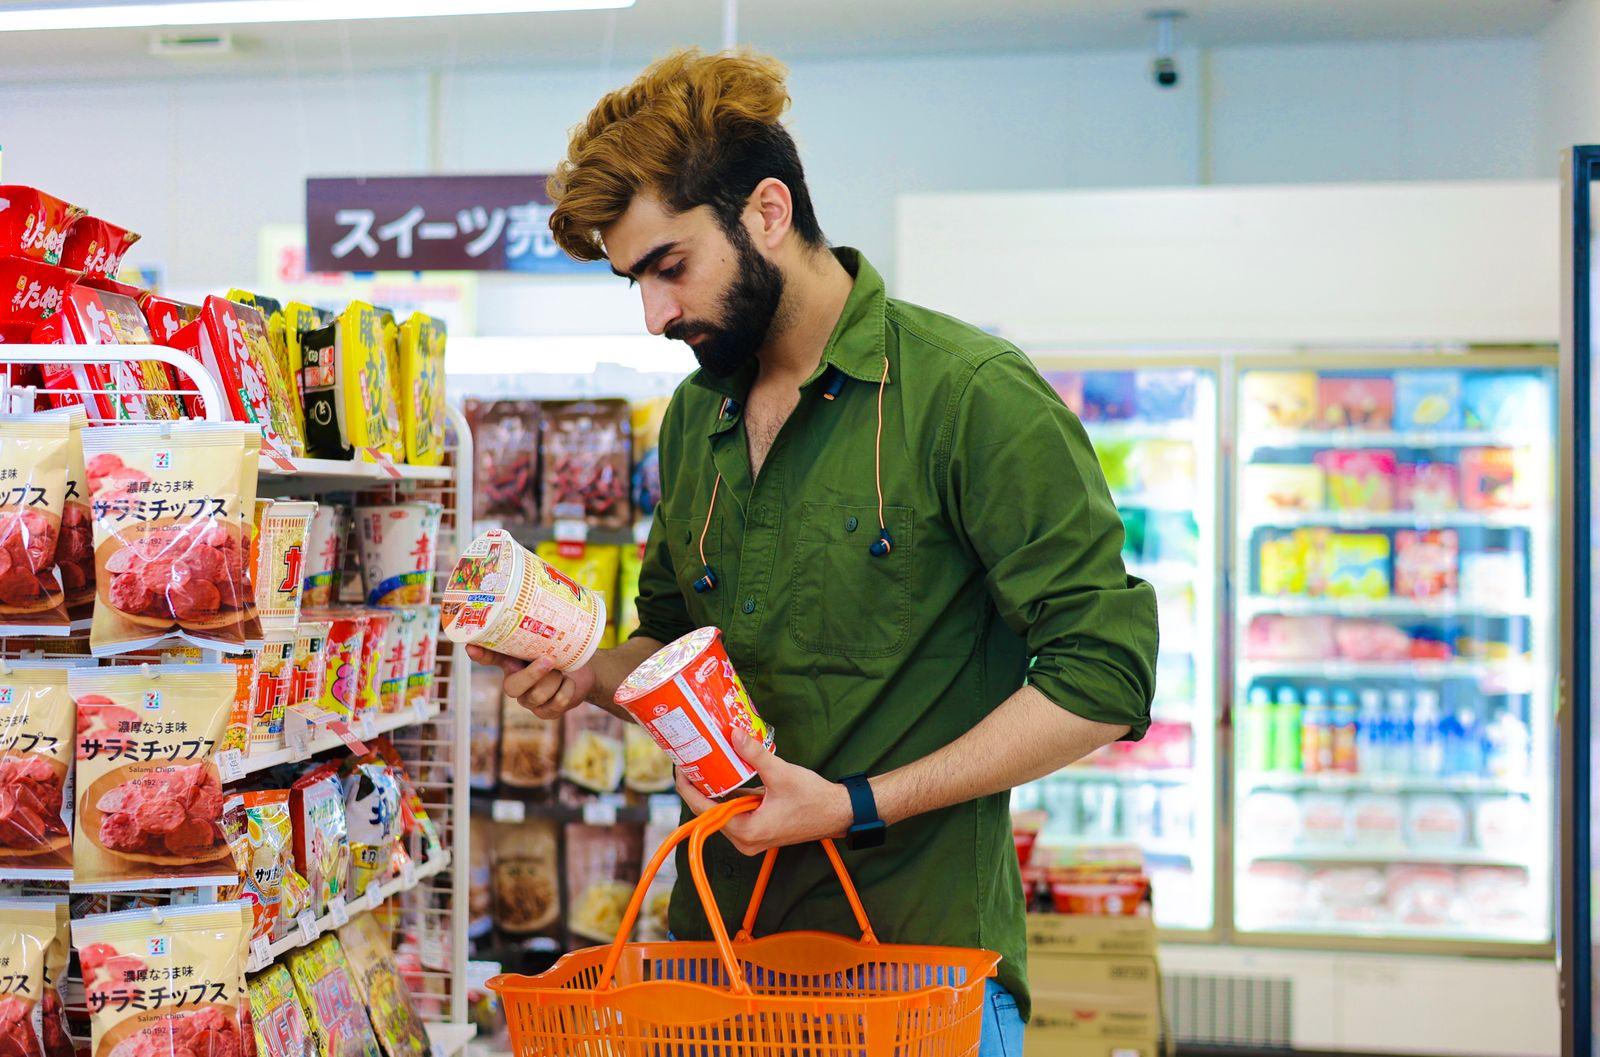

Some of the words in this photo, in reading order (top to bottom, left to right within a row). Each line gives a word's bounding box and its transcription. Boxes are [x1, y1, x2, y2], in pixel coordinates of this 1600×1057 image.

[126, 480, 195, 494] 濃厚なうま味
[92, 494, 228, 523] サラミチップス
[118, 720, 188, 734] 濃厚なうま味
[155, 766, 176, 774] Chips
[123, 965, 194, 983] 濃厚なうま味
[89, 979, 229, 1014] サラミチップス
[137, 1015, 163, 1023] Salami
